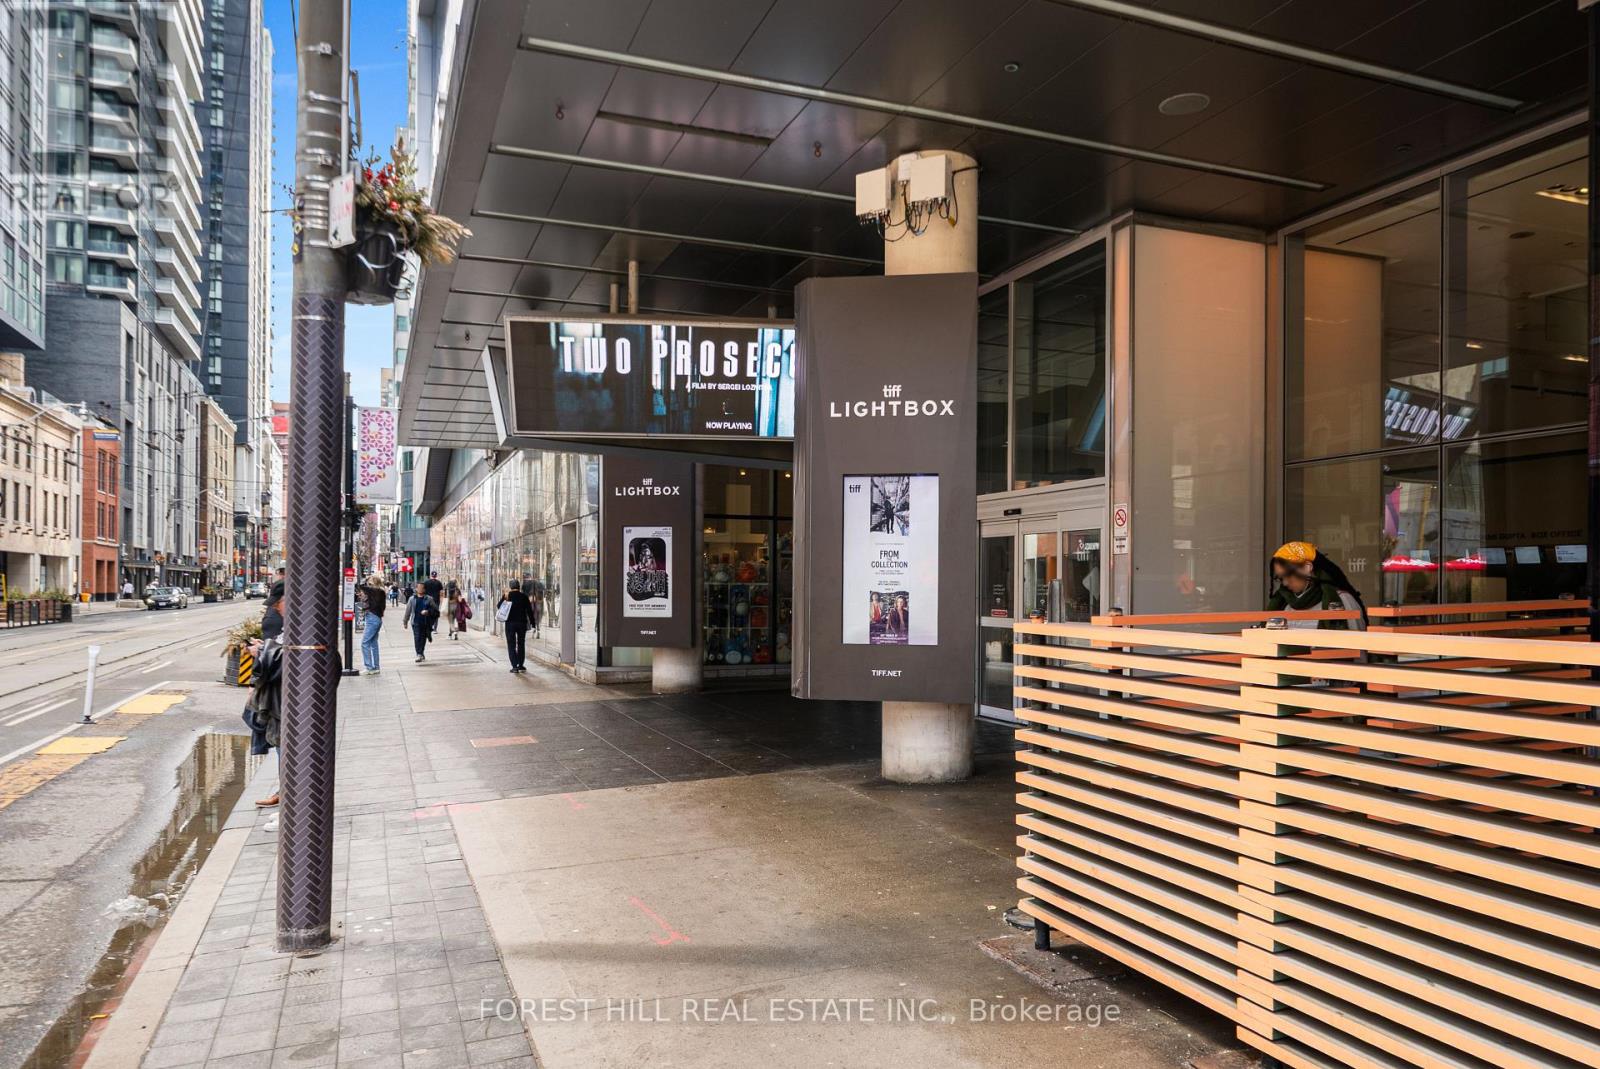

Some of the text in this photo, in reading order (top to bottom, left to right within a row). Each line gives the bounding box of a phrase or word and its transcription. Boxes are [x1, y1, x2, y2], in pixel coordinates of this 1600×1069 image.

[558, 336, 632, 375] TWO
[691, 382, 707, 391] FILM
[708, 382, 717, 391] BY
[717, 383, 741, 391] SERGEI
[882, 384, 902, 398] tiff
[830, 399, 955, 418] LIGHTBOX
[705, 421, 753, 430] NOW PLAYING
[642, 478, 653, 486] tiff
[615, 486, 680, 497] LIGHTBOX
[849, 484, 862, 493] tiff
[879, 550, 900, 560] FROM
[870, 561, 909, 569] COLLECTION
[1347, 557, 1367, 573] tiff
[871, 669, 902, 677] TIFF.NET
